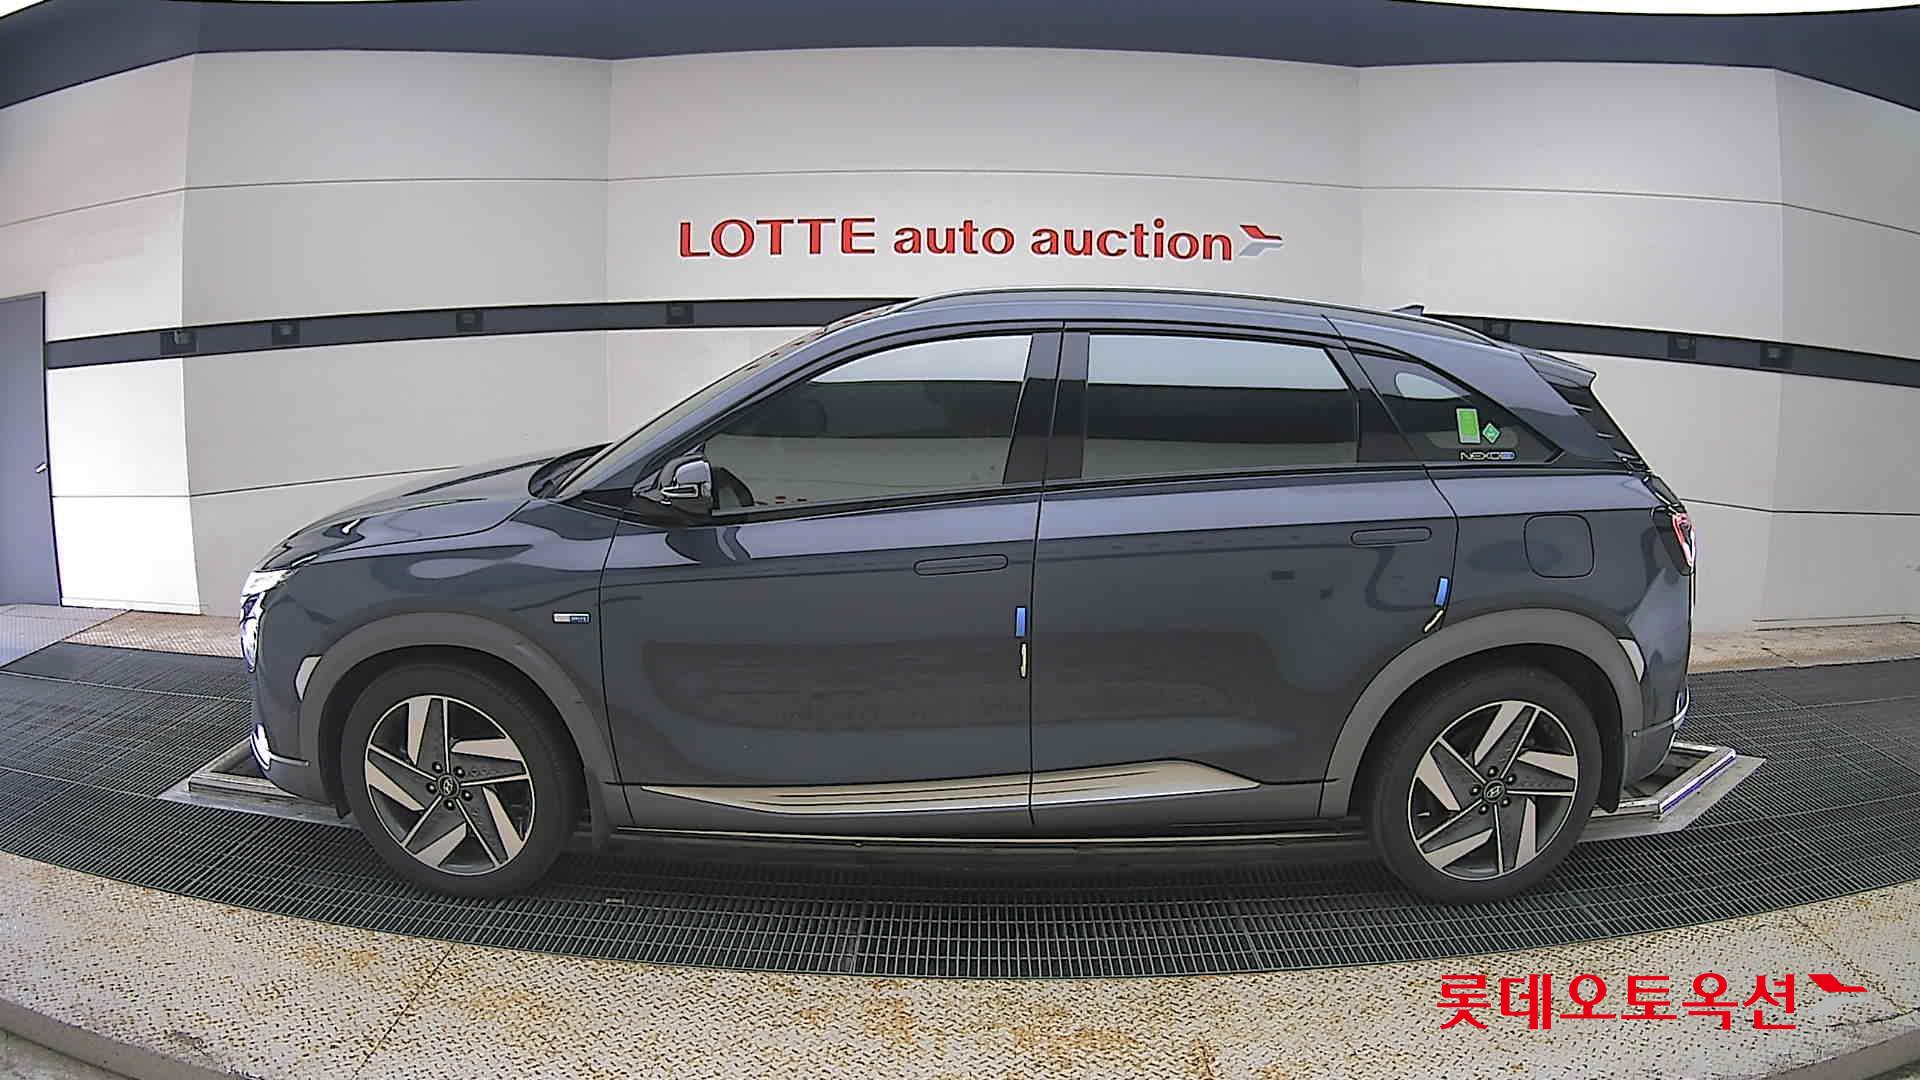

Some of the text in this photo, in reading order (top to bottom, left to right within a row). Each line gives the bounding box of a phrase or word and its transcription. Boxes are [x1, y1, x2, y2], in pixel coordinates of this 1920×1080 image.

[680, 217, 1232, 261] LOTTE auto auction
